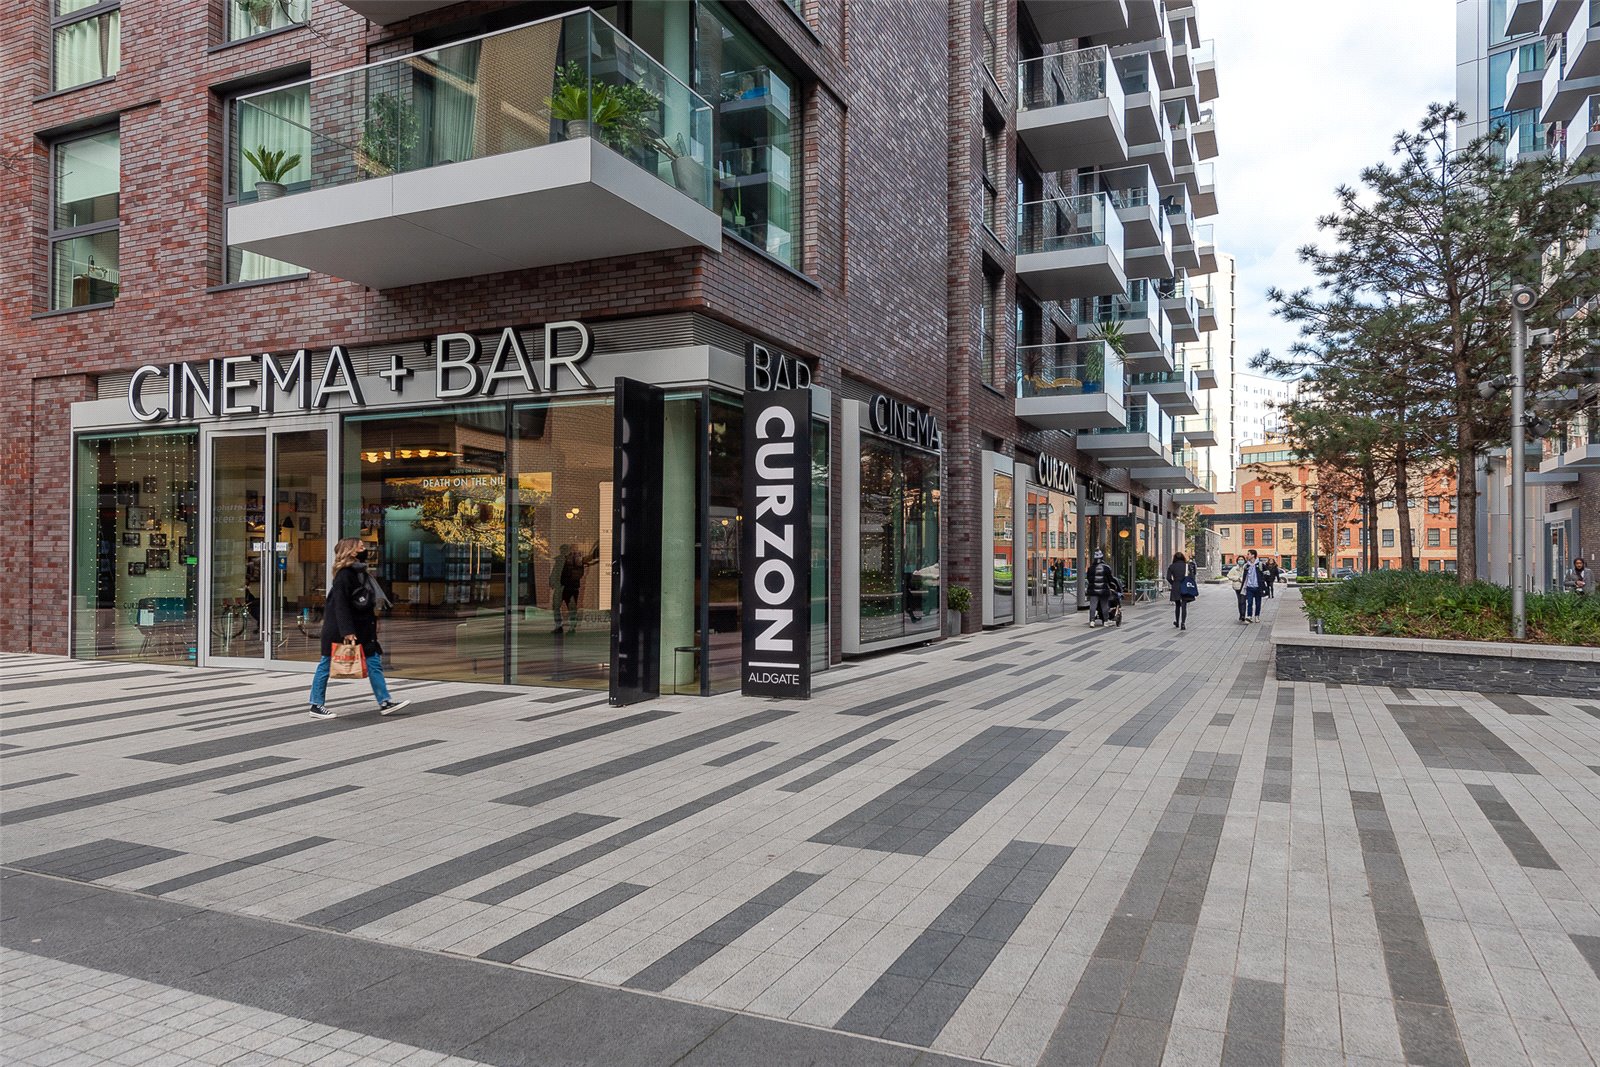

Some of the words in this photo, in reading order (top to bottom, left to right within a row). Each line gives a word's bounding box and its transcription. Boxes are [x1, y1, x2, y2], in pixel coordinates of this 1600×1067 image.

[127, 345, 366, 422] CINEMA
[379, 354, 414, 394] +
[436, 320, 597, 399] BAR
[752, 342, 811, 392] BAR
[871, 394, 940, 449] CINEMA
[423, 478, 451, 488] DEATH
[453, 477, 468, 487] ON
[470, 477, 487, 486] THE
[490, 476, 506, 486] NIL
[1038, 451, 1078, 497] CURZON
[754, 405, 796, 652] CURZON
[748, 672, 800, 685] ALDGATE
